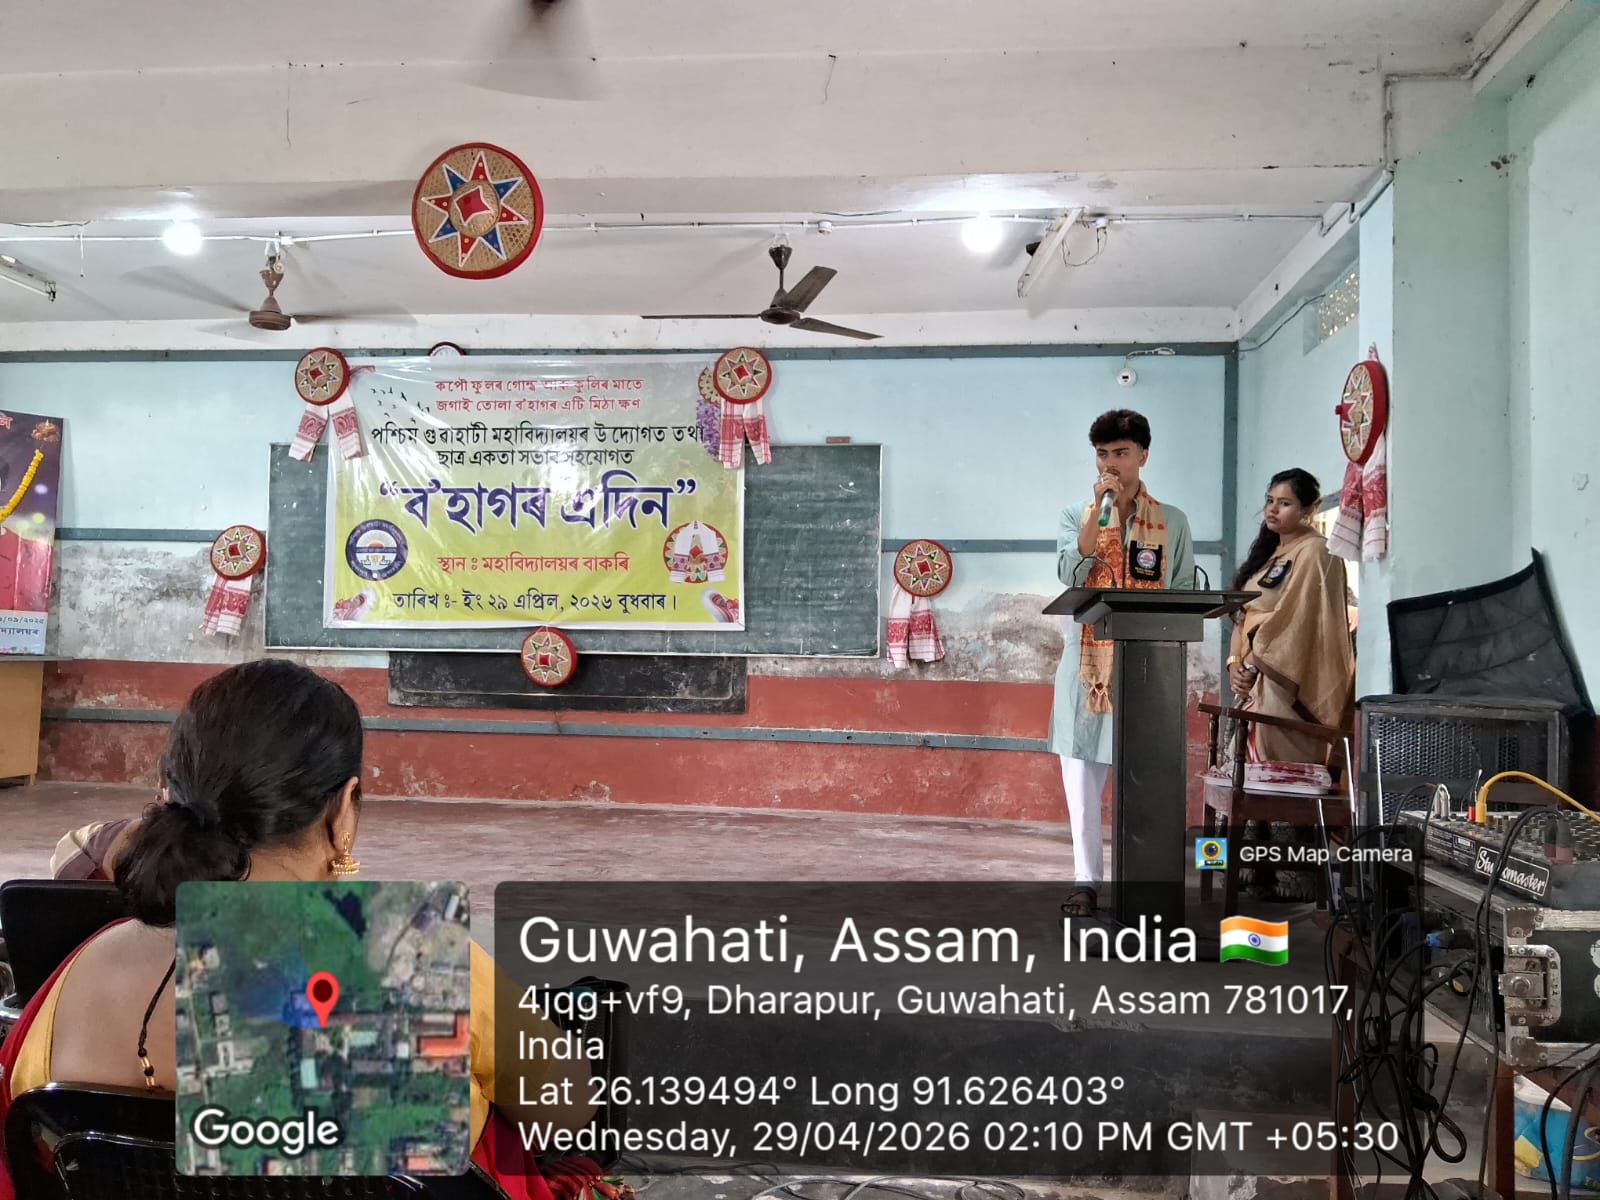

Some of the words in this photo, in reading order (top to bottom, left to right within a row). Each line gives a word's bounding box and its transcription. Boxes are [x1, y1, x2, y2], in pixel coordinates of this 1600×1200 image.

[612, 379, 645, 391] মাতে
[435, 397, 473, 412] জগাই
[476, 400, 512, 412] তোলা
[561, 395, 586, 410] এটি
[671, 424, 704, 443] তথা
[469, 448, 516, 466] একতা
[437, 556, 467, 575] স্থান
[582, 551, 630, 572] বাকৰি
[392, 587, 440, 609] তাৰিখ
[461, 588, 484, 611] ইং
[488, 594, 508, 610] ২৯
[570, 594, 613, 611] ২০২৬
[617, 593, 667, 614] বুধবাৰ
[1476, 850, 1545, 893] Stuomaster
